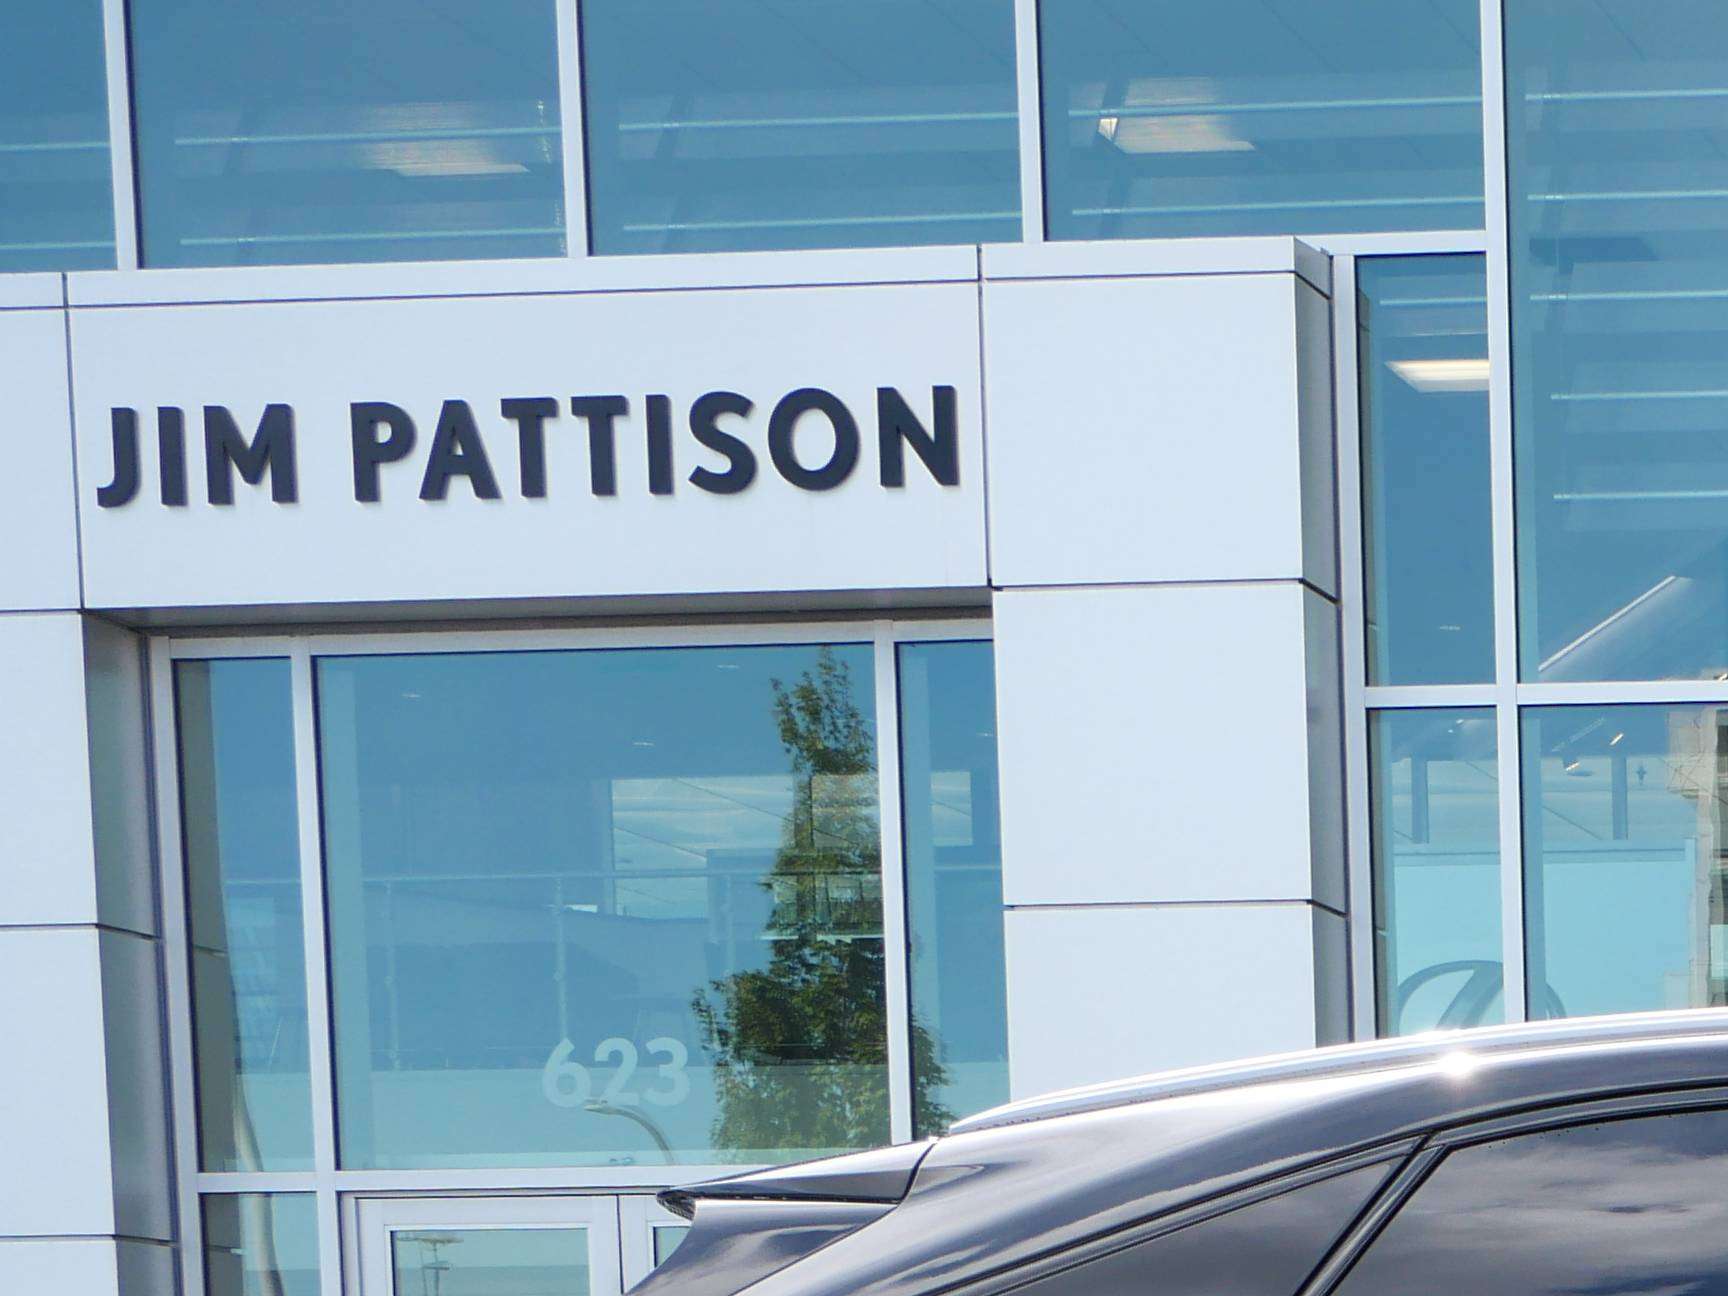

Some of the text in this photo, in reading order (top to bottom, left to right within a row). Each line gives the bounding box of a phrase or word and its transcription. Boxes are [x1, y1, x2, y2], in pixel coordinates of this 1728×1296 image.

[97, 385, 960, 508] JIM PATTISON
[541, 1036, 691, 1108] 623
